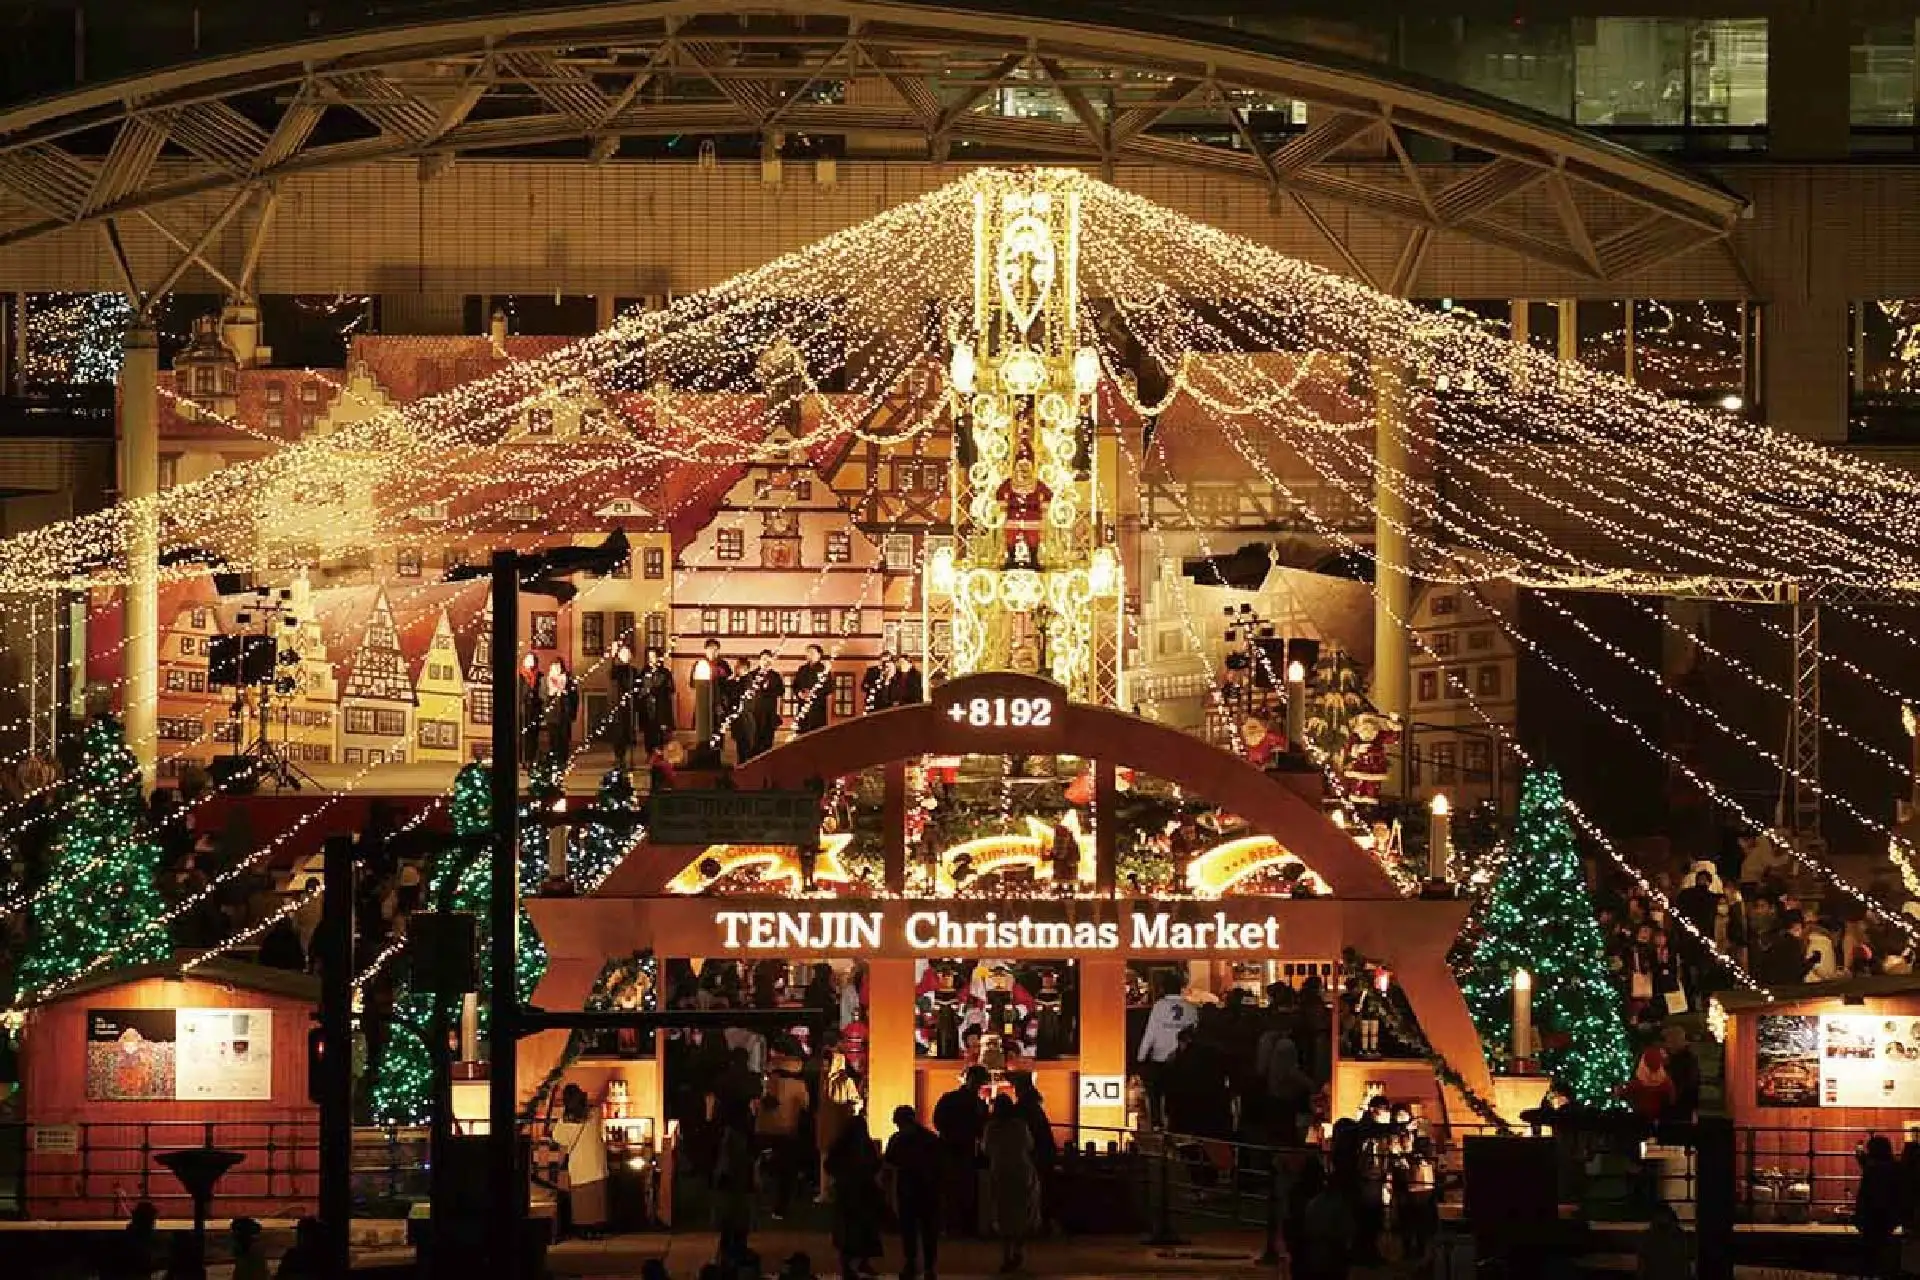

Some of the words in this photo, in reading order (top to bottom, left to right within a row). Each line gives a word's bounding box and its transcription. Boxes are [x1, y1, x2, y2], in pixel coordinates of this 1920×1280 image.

[947, 697, 1052, 727] +8192
[715, 911, 883, 950] TENJIN
[904, 911, 1118, 950] Christmas
[1130, 911, 1280, 950] Market
[1084, 1081, 1120, 1099] 入口
